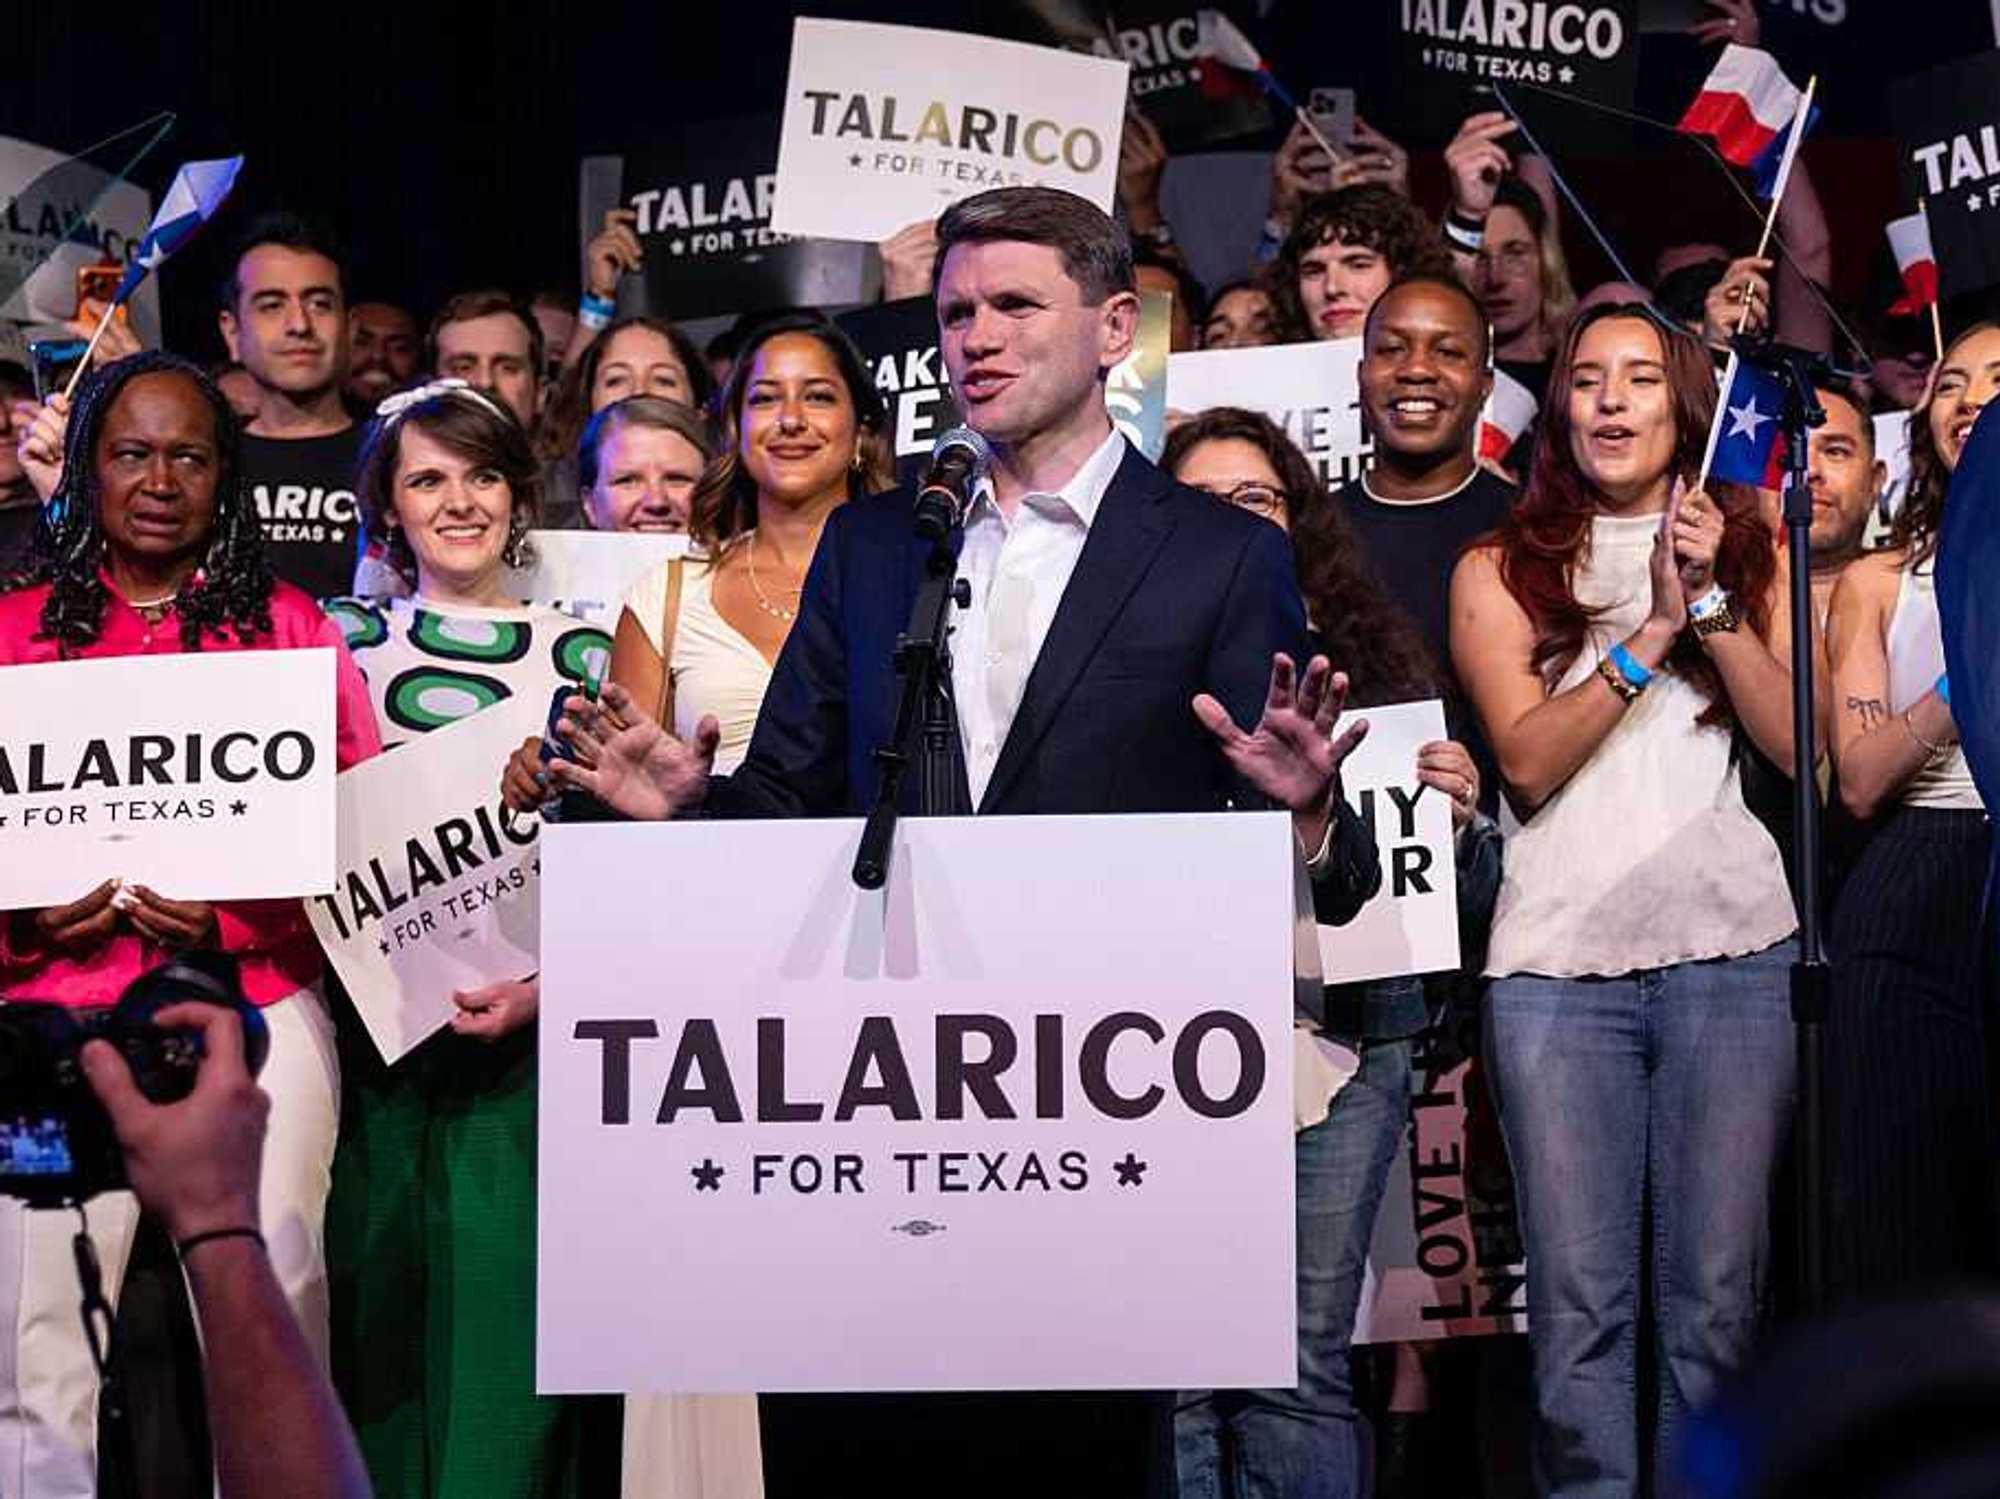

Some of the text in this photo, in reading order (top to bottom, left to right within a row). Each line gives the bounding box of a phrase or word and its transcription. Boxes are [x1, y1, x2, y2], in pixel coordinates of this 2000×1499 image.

[1436, 49, 1551, 83] FOR TEXAS
[803, 90, 1104, 175] TALARICO
[874, 152, 925, 175] FOR
[690, 232, 735, 255] FOR
[23, 799, 216, 827] FOR TEXAS
[393, 866, 525, 949] FOR TEXAS
[573, 1009, 1267, 1126] TALARICO
[751, 1150, 1091, 1195] FOR TEXAS
[1411, 1142, 1473, 1321] LOVE
